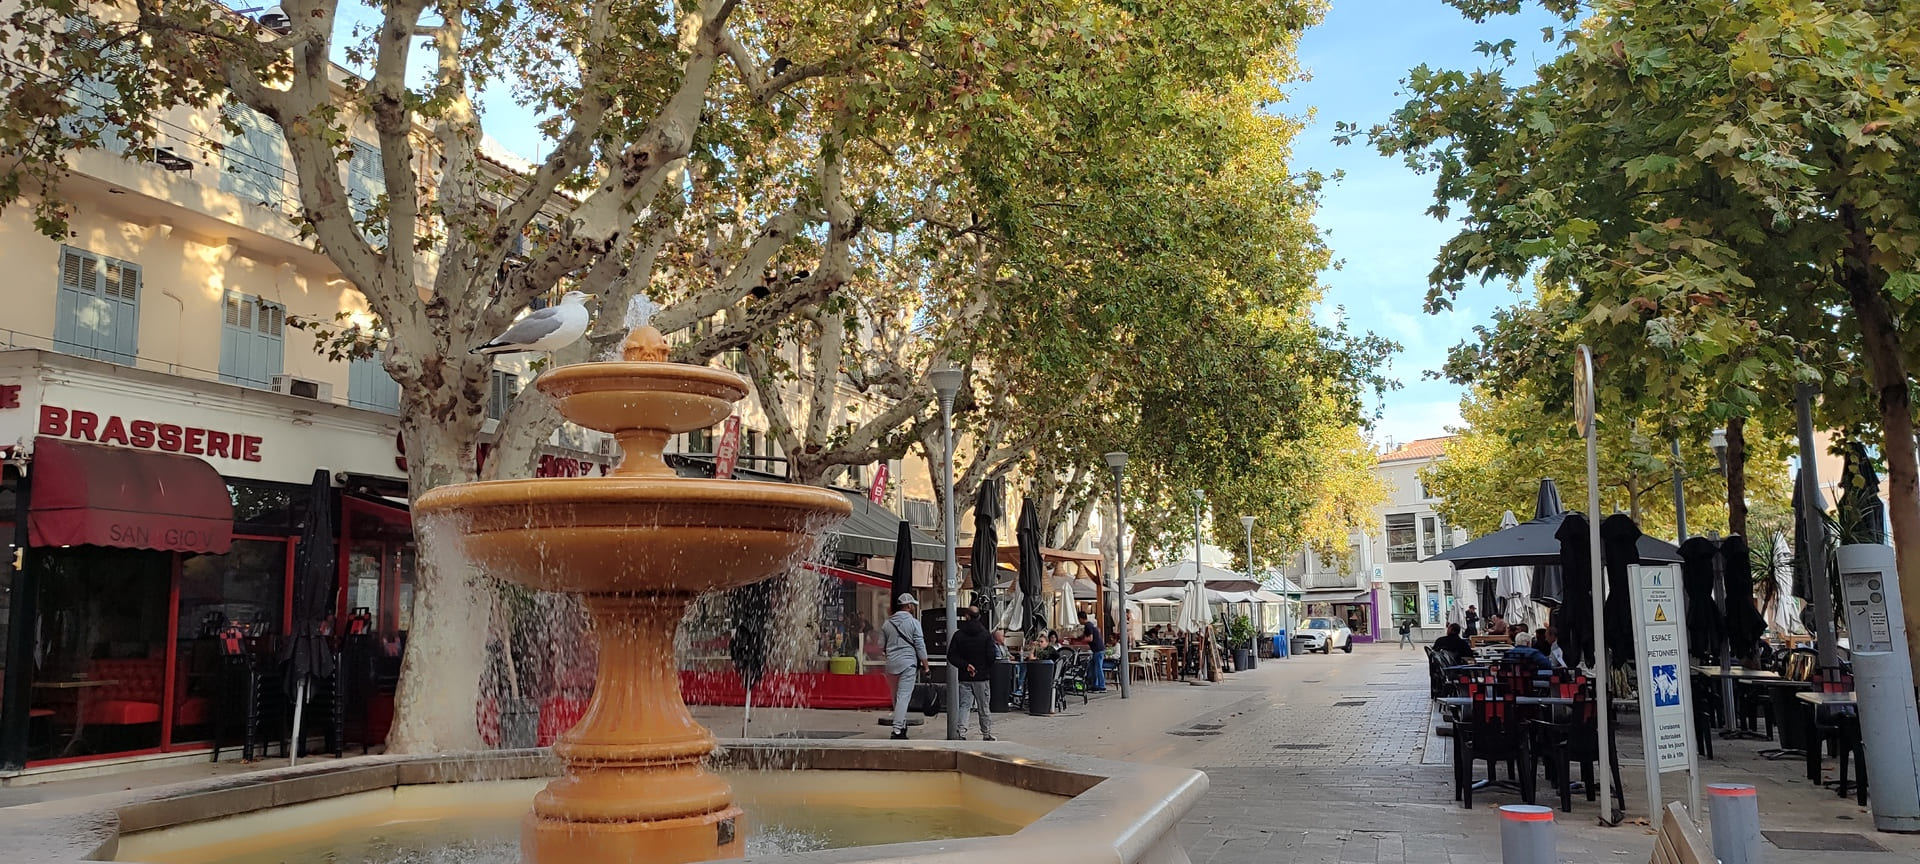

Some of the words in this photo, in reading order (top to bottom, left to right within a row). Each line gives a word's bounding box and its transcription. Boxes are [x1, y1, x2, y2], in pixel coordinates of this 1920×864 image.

[39, 404, 263, 462] BRASSERIE
[717, 417, 738, 479] TABA
[109, 524, 149, 544] SAN
[1651, 633, 1672, 641] ESPACE
